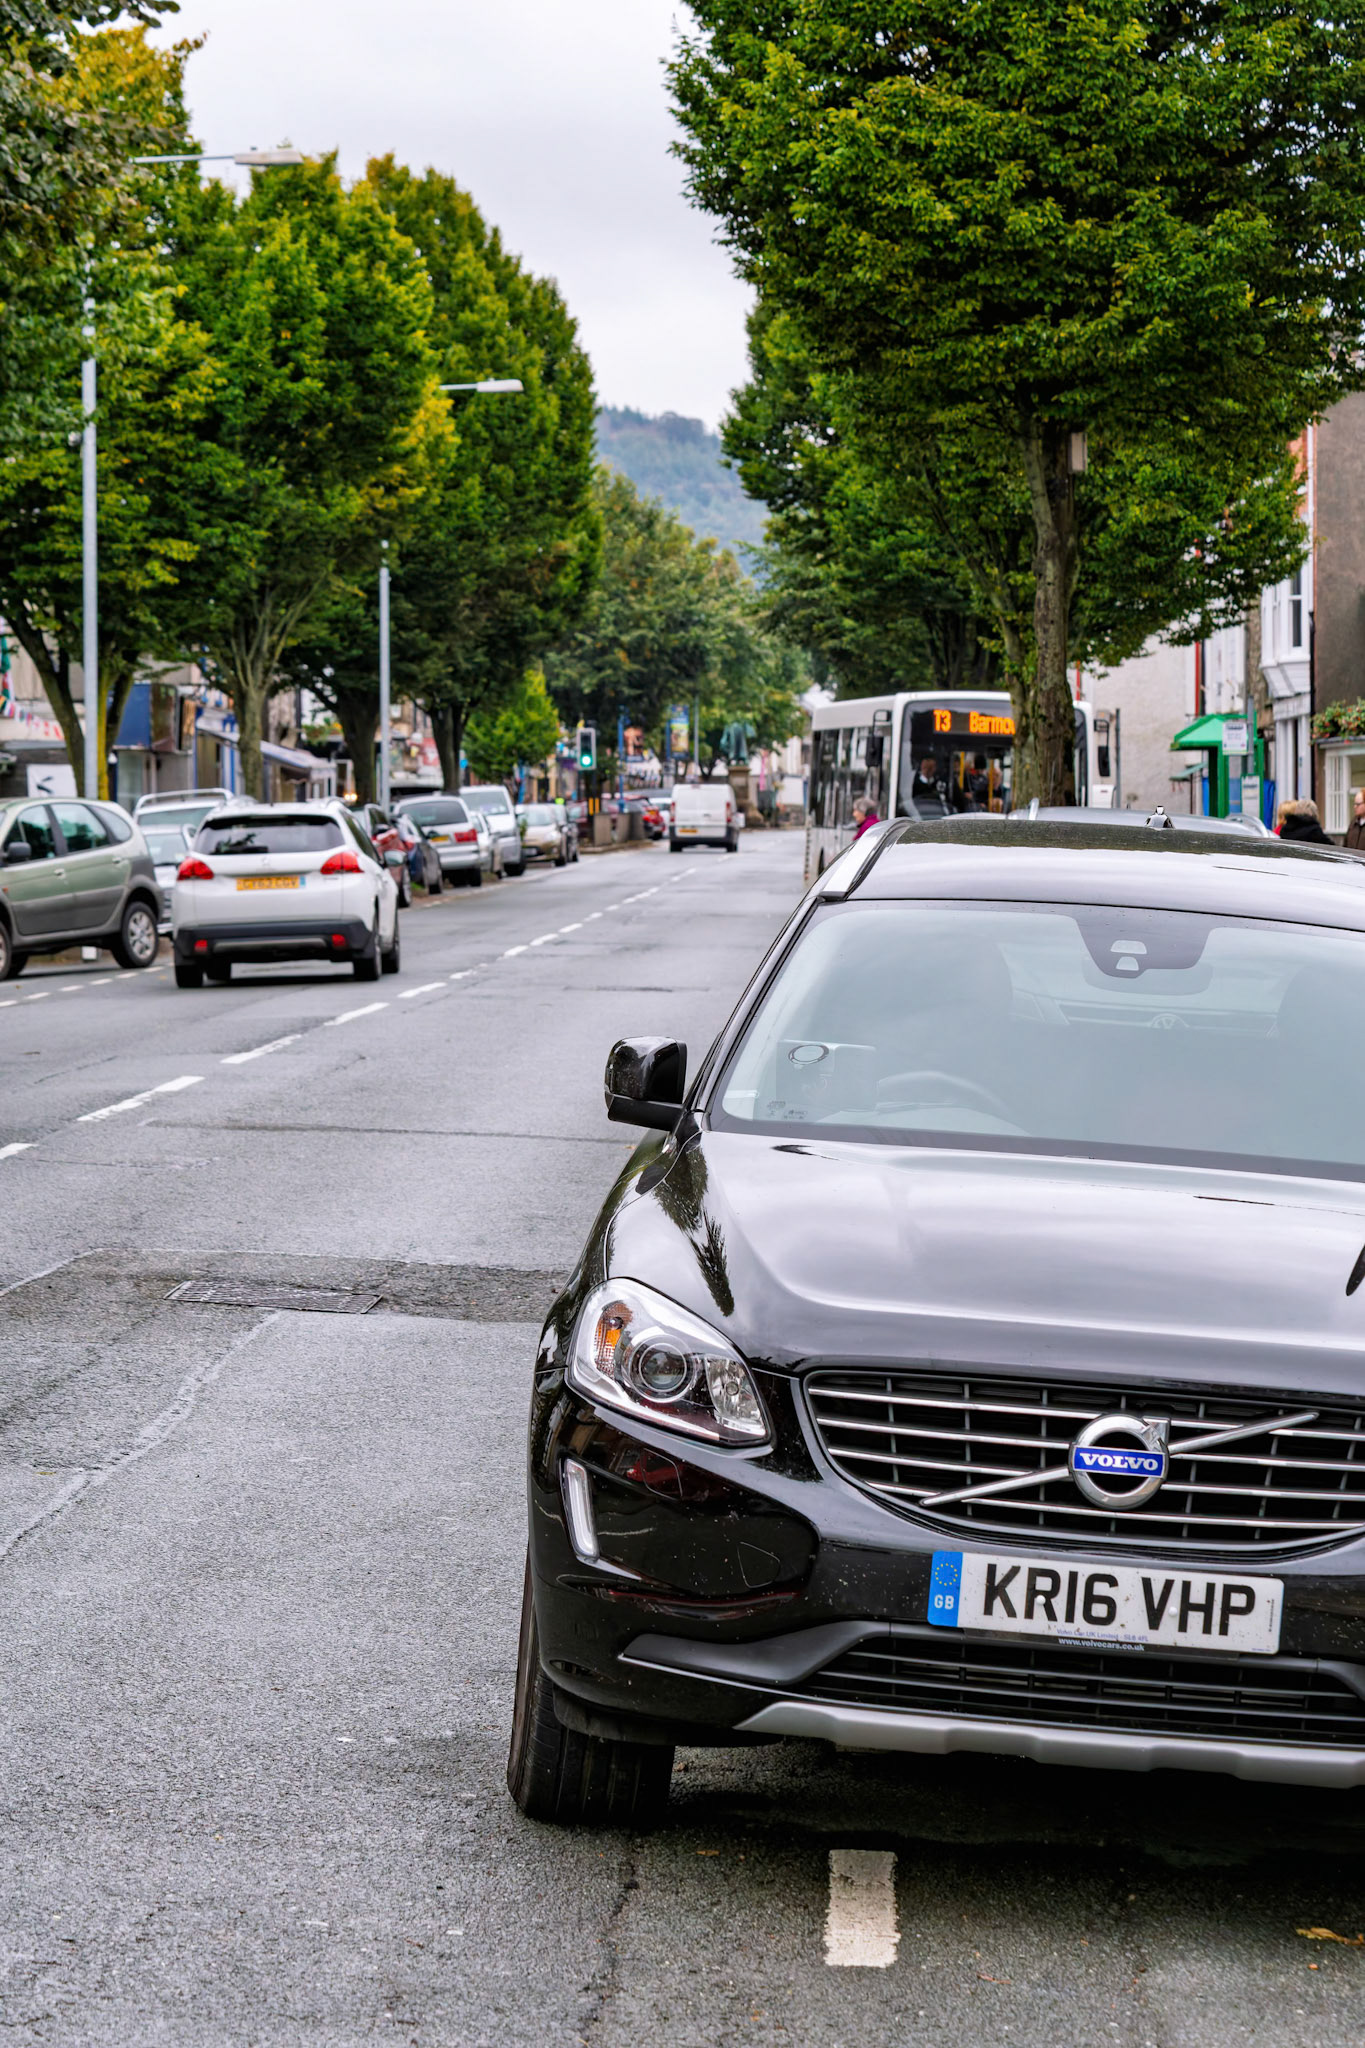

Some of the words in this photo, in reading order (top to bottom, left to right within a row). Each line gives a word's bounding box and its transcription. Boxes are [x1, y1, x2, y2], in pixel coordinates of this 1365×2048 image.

[933, 709, 951, 732] T3
[1079, 1452, 1159, 1471] VOLVO
[934, 1594, 954, 1610] GB
[982, 1563, 1119, 1627] KR16
[1141, 1576, 1256, 1637] VHP
[1058, 1637, 1145, 1651] www.volvocars.co.uk
